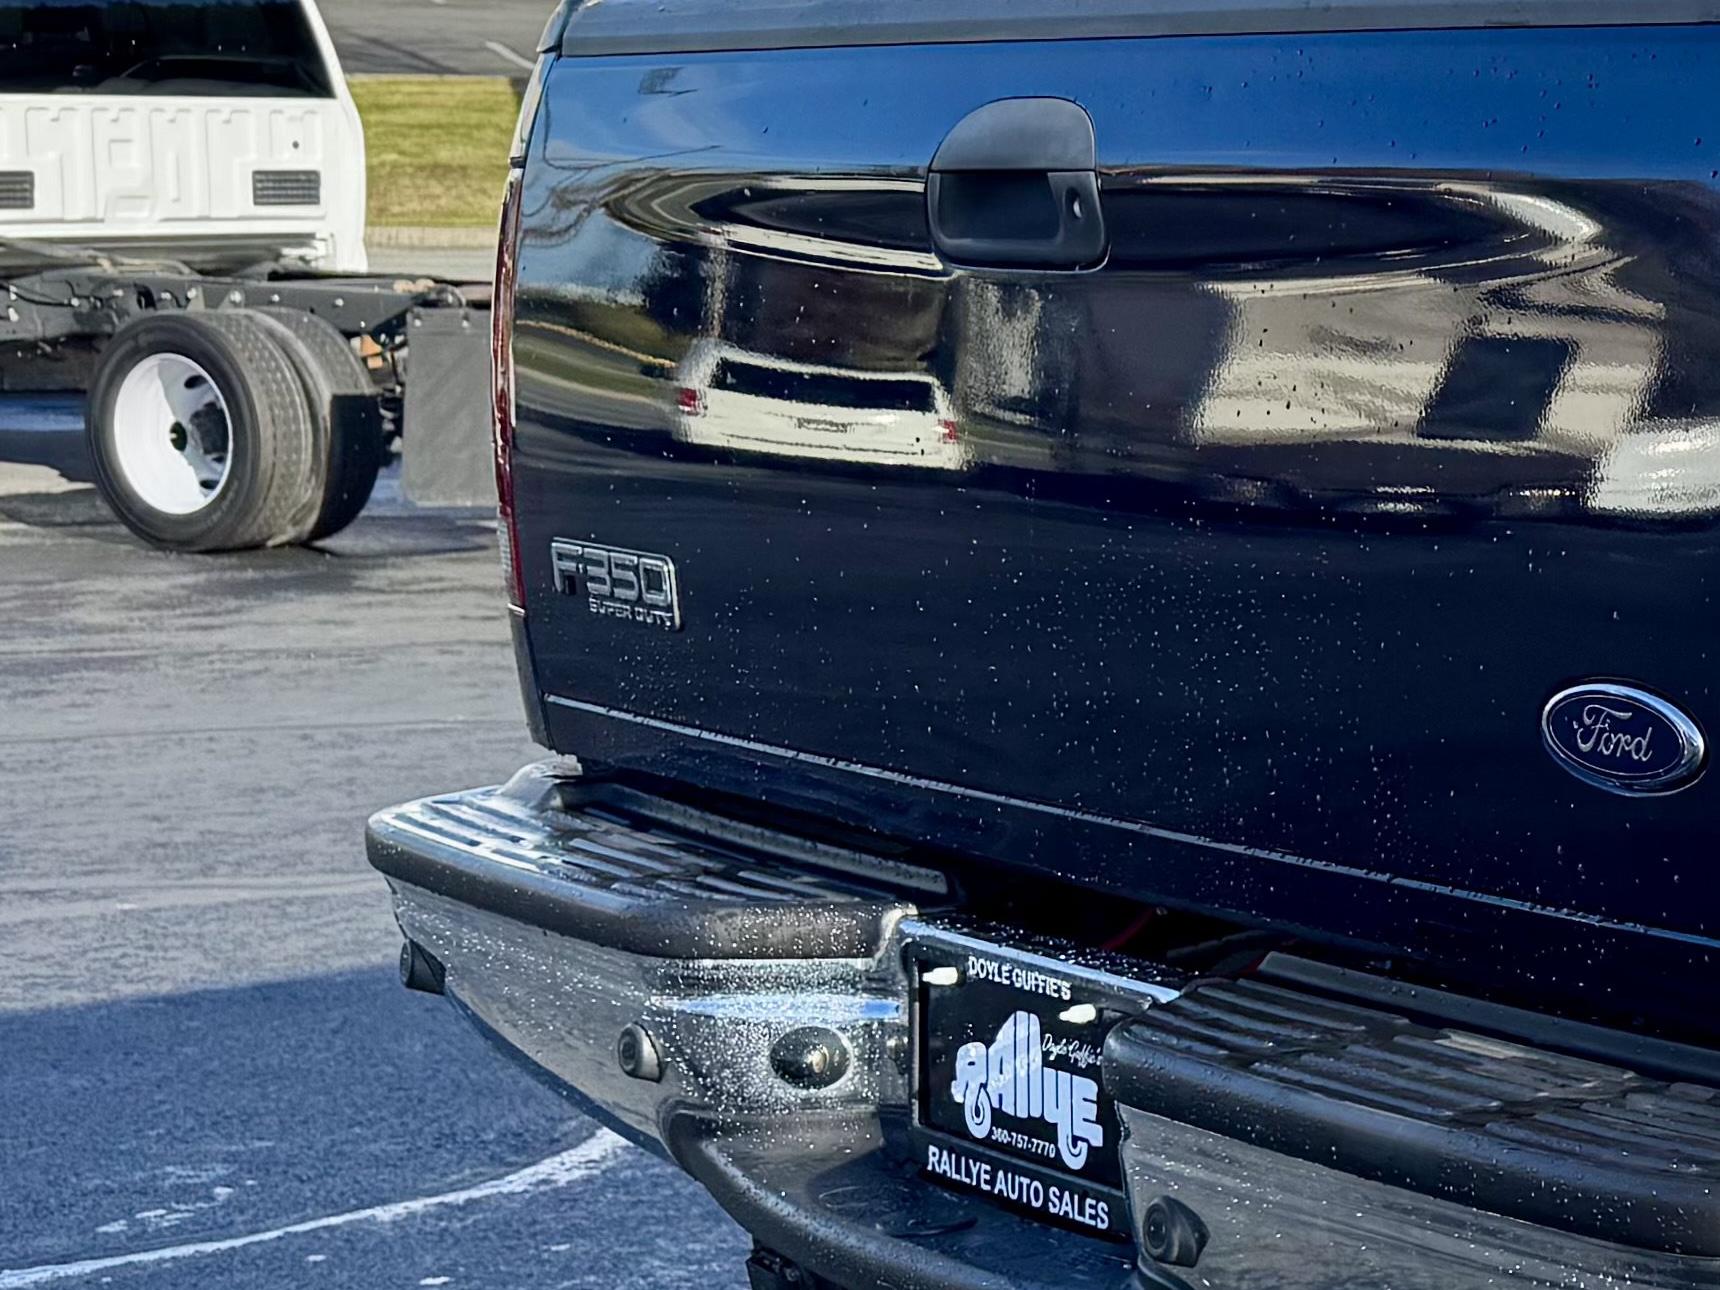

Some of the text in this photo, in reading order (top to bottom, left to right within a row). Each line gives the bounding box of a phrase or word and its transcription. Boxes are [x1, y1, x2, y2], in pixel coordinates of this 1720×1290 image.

[589, 596, 632, 621] SUPER
[1573, 703, 1653, 762] Ford
[967, 955, 1012, 985] DOYLE
[927, 1144, 1109, 1229] RALLYE AUTO SALES
